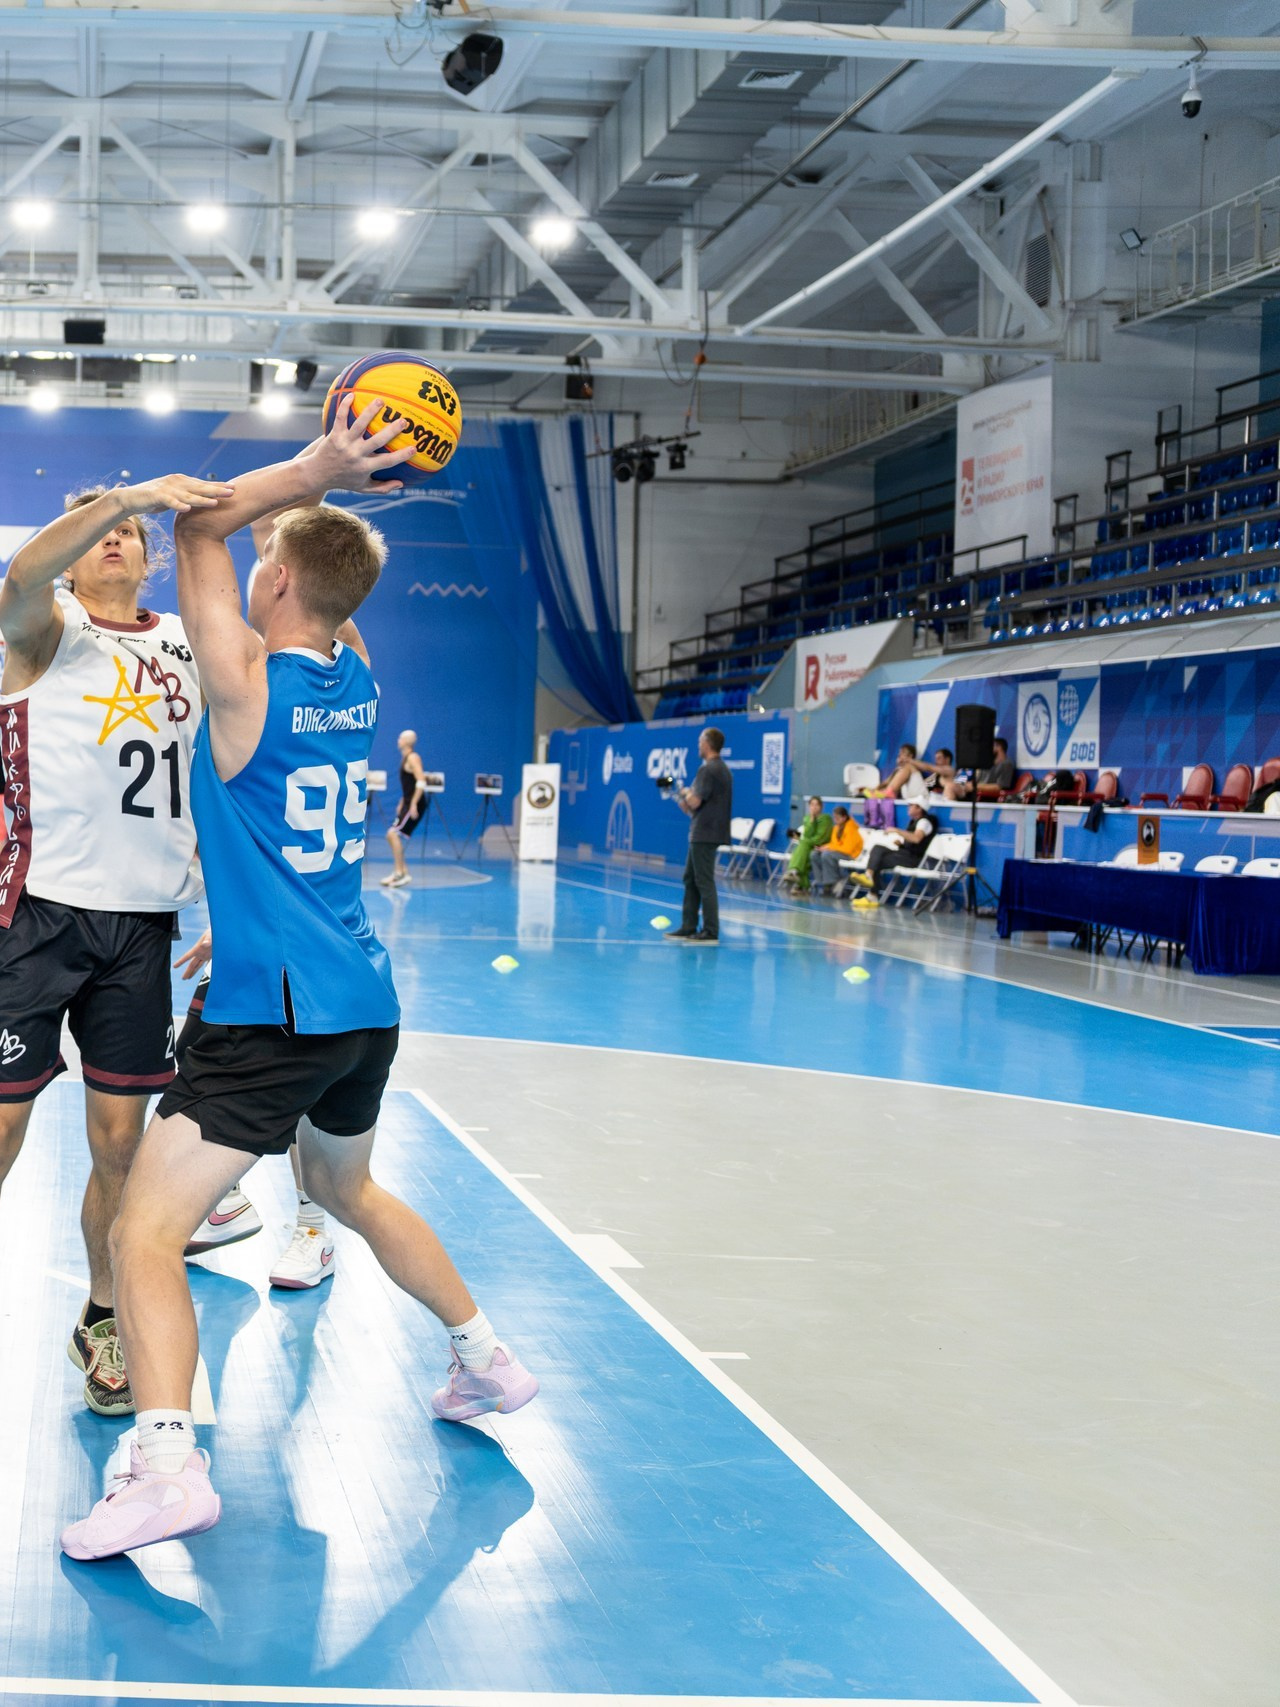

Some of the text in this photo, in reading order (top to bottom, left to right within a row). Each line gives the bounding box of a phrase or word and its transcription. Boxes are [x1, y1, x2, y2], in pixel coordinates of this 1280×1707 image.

[381, 405, 453, 465] Wilson
[118, 739, 181, 819] 21
[1070, 741, 1096, 763] ВФВ
